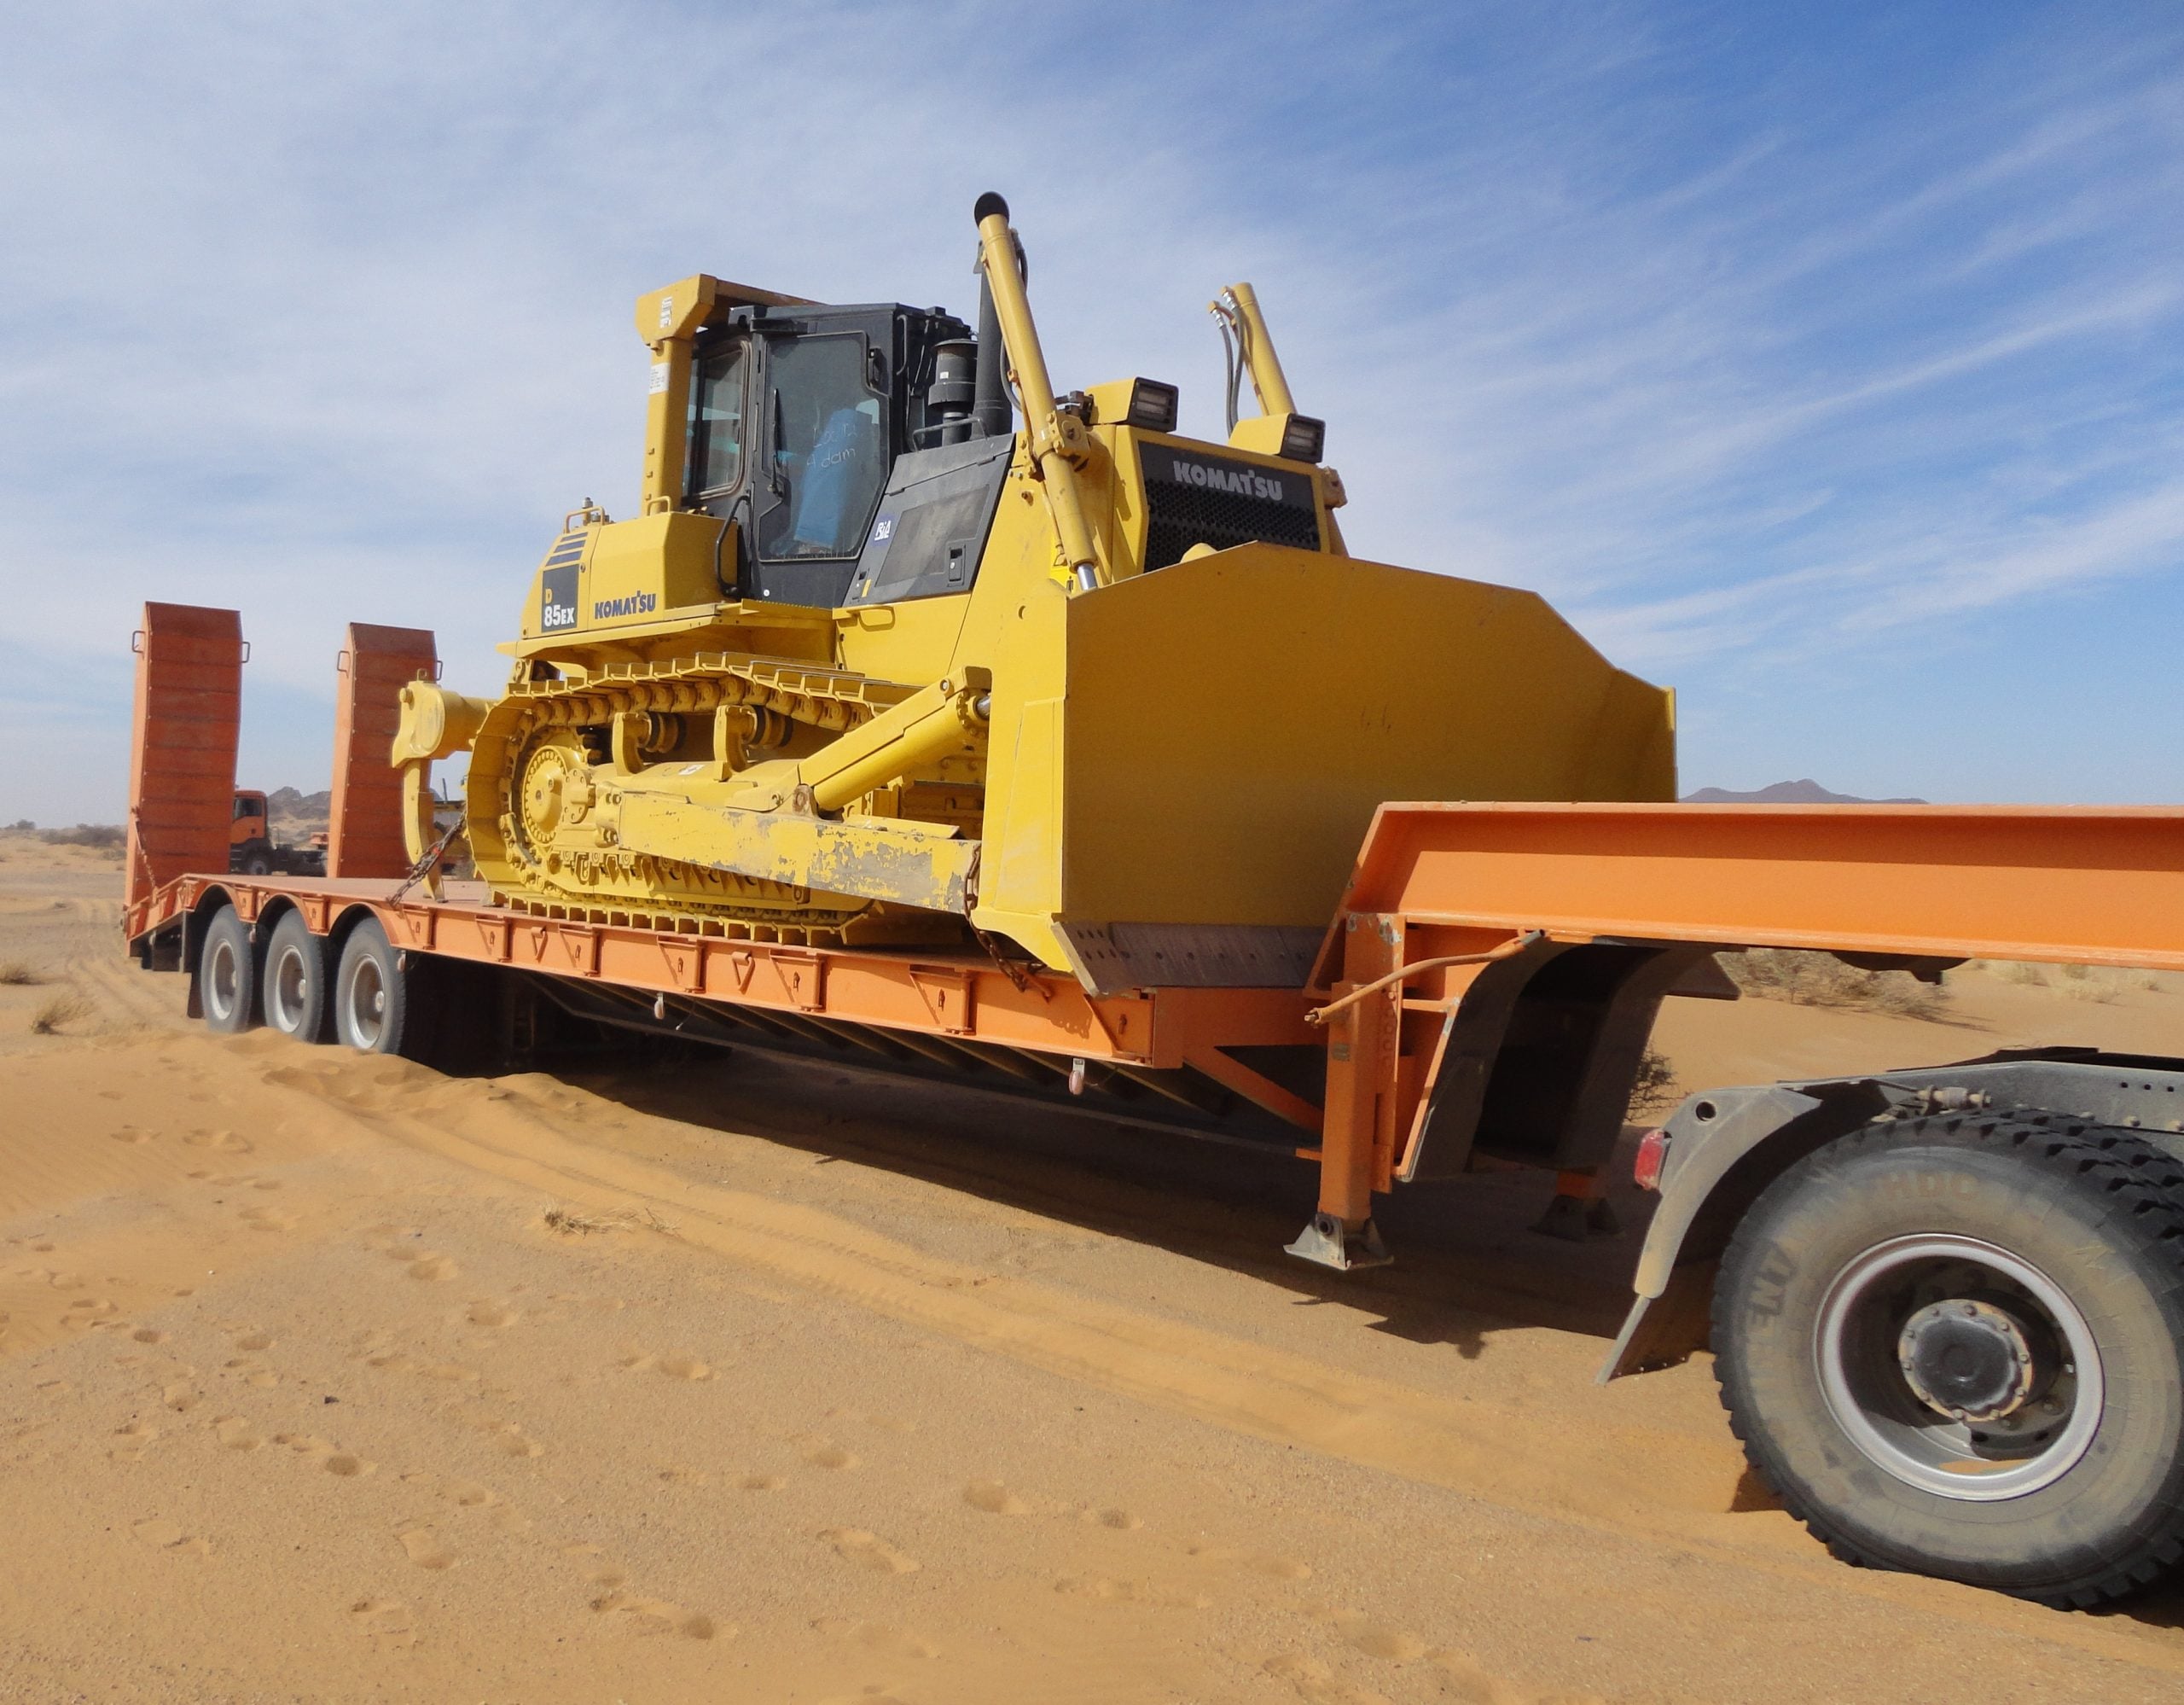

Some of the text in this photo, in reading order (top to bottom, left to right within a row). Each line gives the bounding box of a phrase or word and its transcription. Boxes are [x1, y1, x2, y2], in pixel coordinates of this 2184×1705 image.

[1173, 460, 1283, 502] KOMATSU
[545, 588, 553, 604] D
[594, 591, 656, 620] KOMATSU
[544, 604, 575, 626] 85EX
